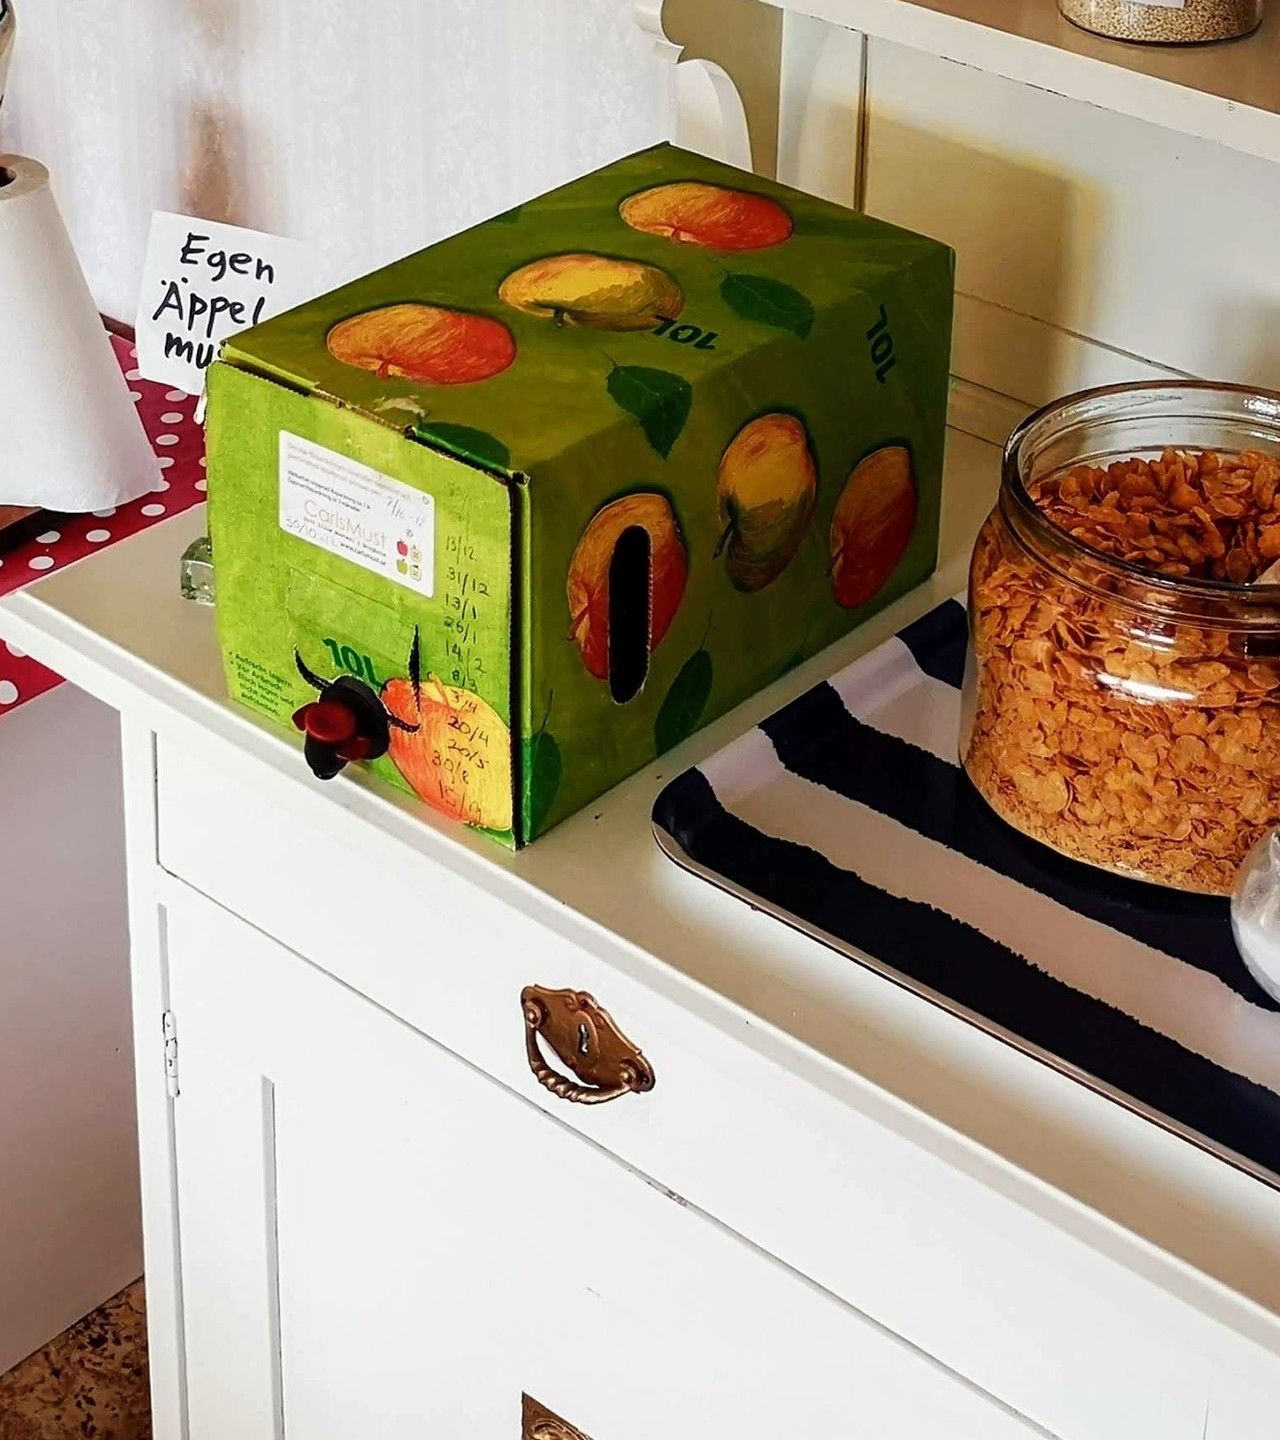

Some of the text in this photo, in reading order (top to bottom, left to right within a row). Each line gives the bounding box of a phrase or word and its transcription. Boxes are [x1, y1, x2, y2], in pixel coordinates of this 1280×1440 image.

[180, 232, 274, 284] Egen
[152, 276, 265, 339] Äppel
[652, 314, 719, 350] 10L
[164, 332, 223, 369] mu
[866, 303, 896, 384] 10L
[304, 499, 386, 548] CarlsMust
[446, 567, 490, 596] 31/12
[322, 637, 384, 688] 10L
[448, 715, 489, 747] 20/4
